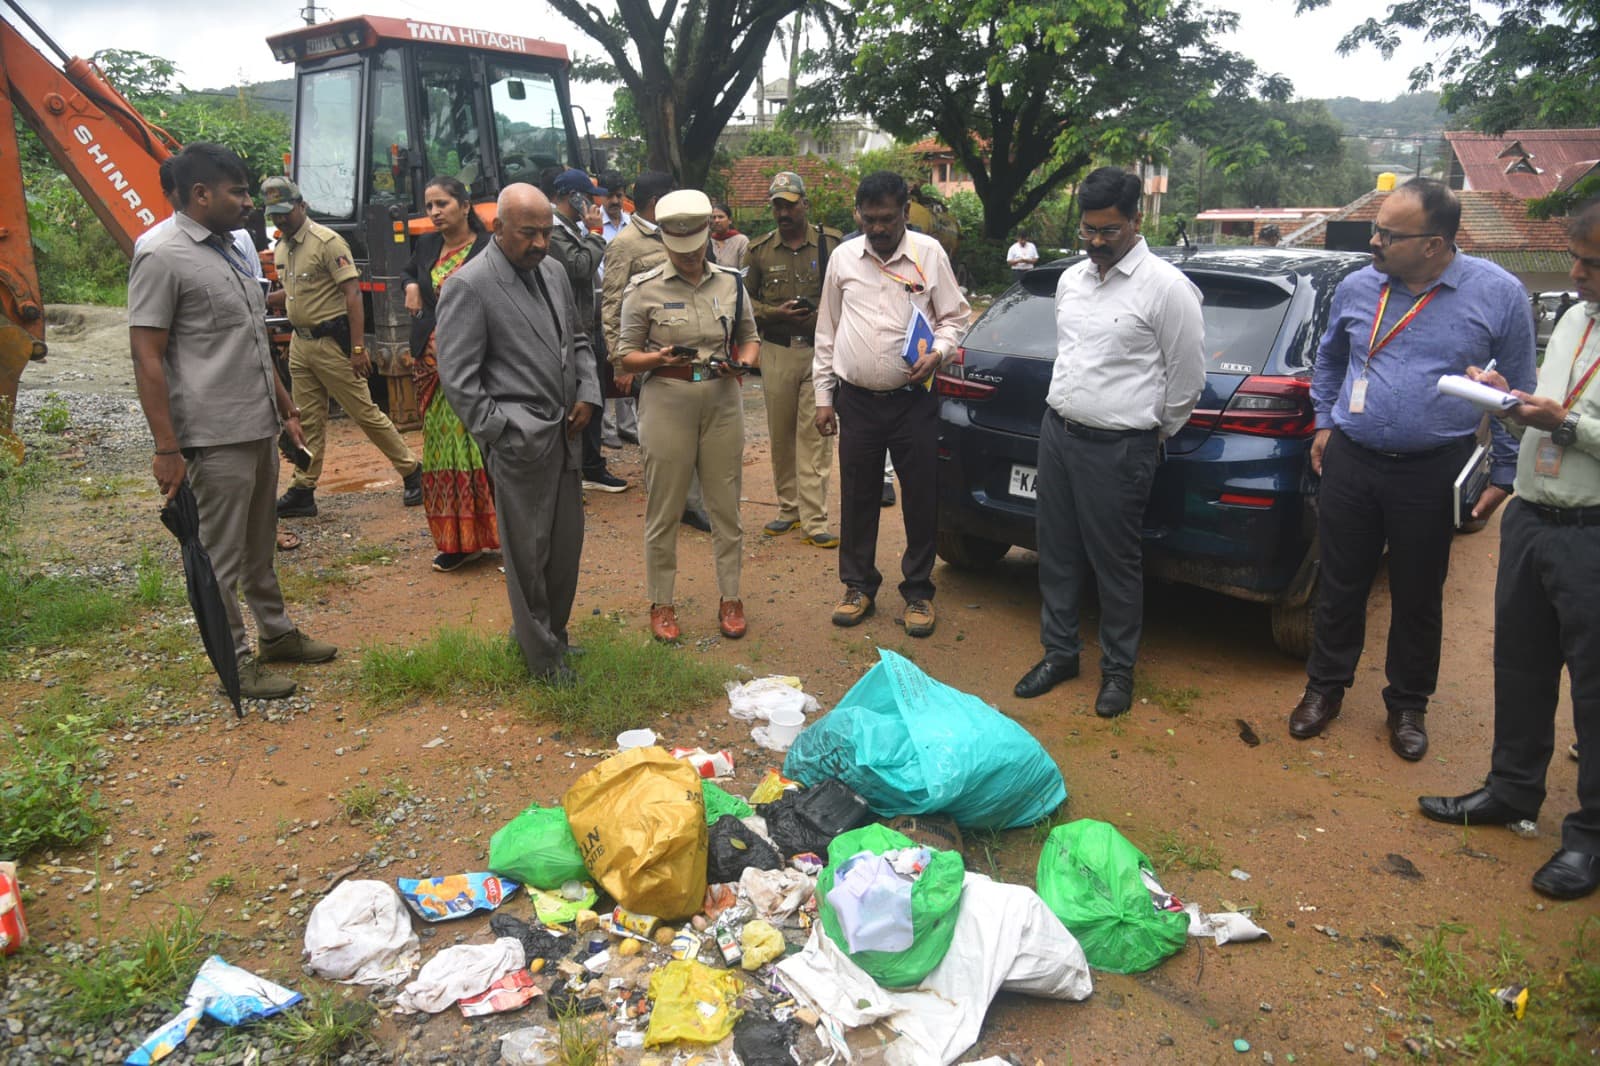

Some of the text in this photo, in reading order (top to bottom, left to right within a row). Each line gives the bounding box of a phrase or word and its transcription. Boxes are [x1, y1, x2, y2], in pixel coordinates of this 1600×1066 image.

[406, 22, 527, 52] TATA HITACHI
[73, 125, 156, 227] SHINRA
